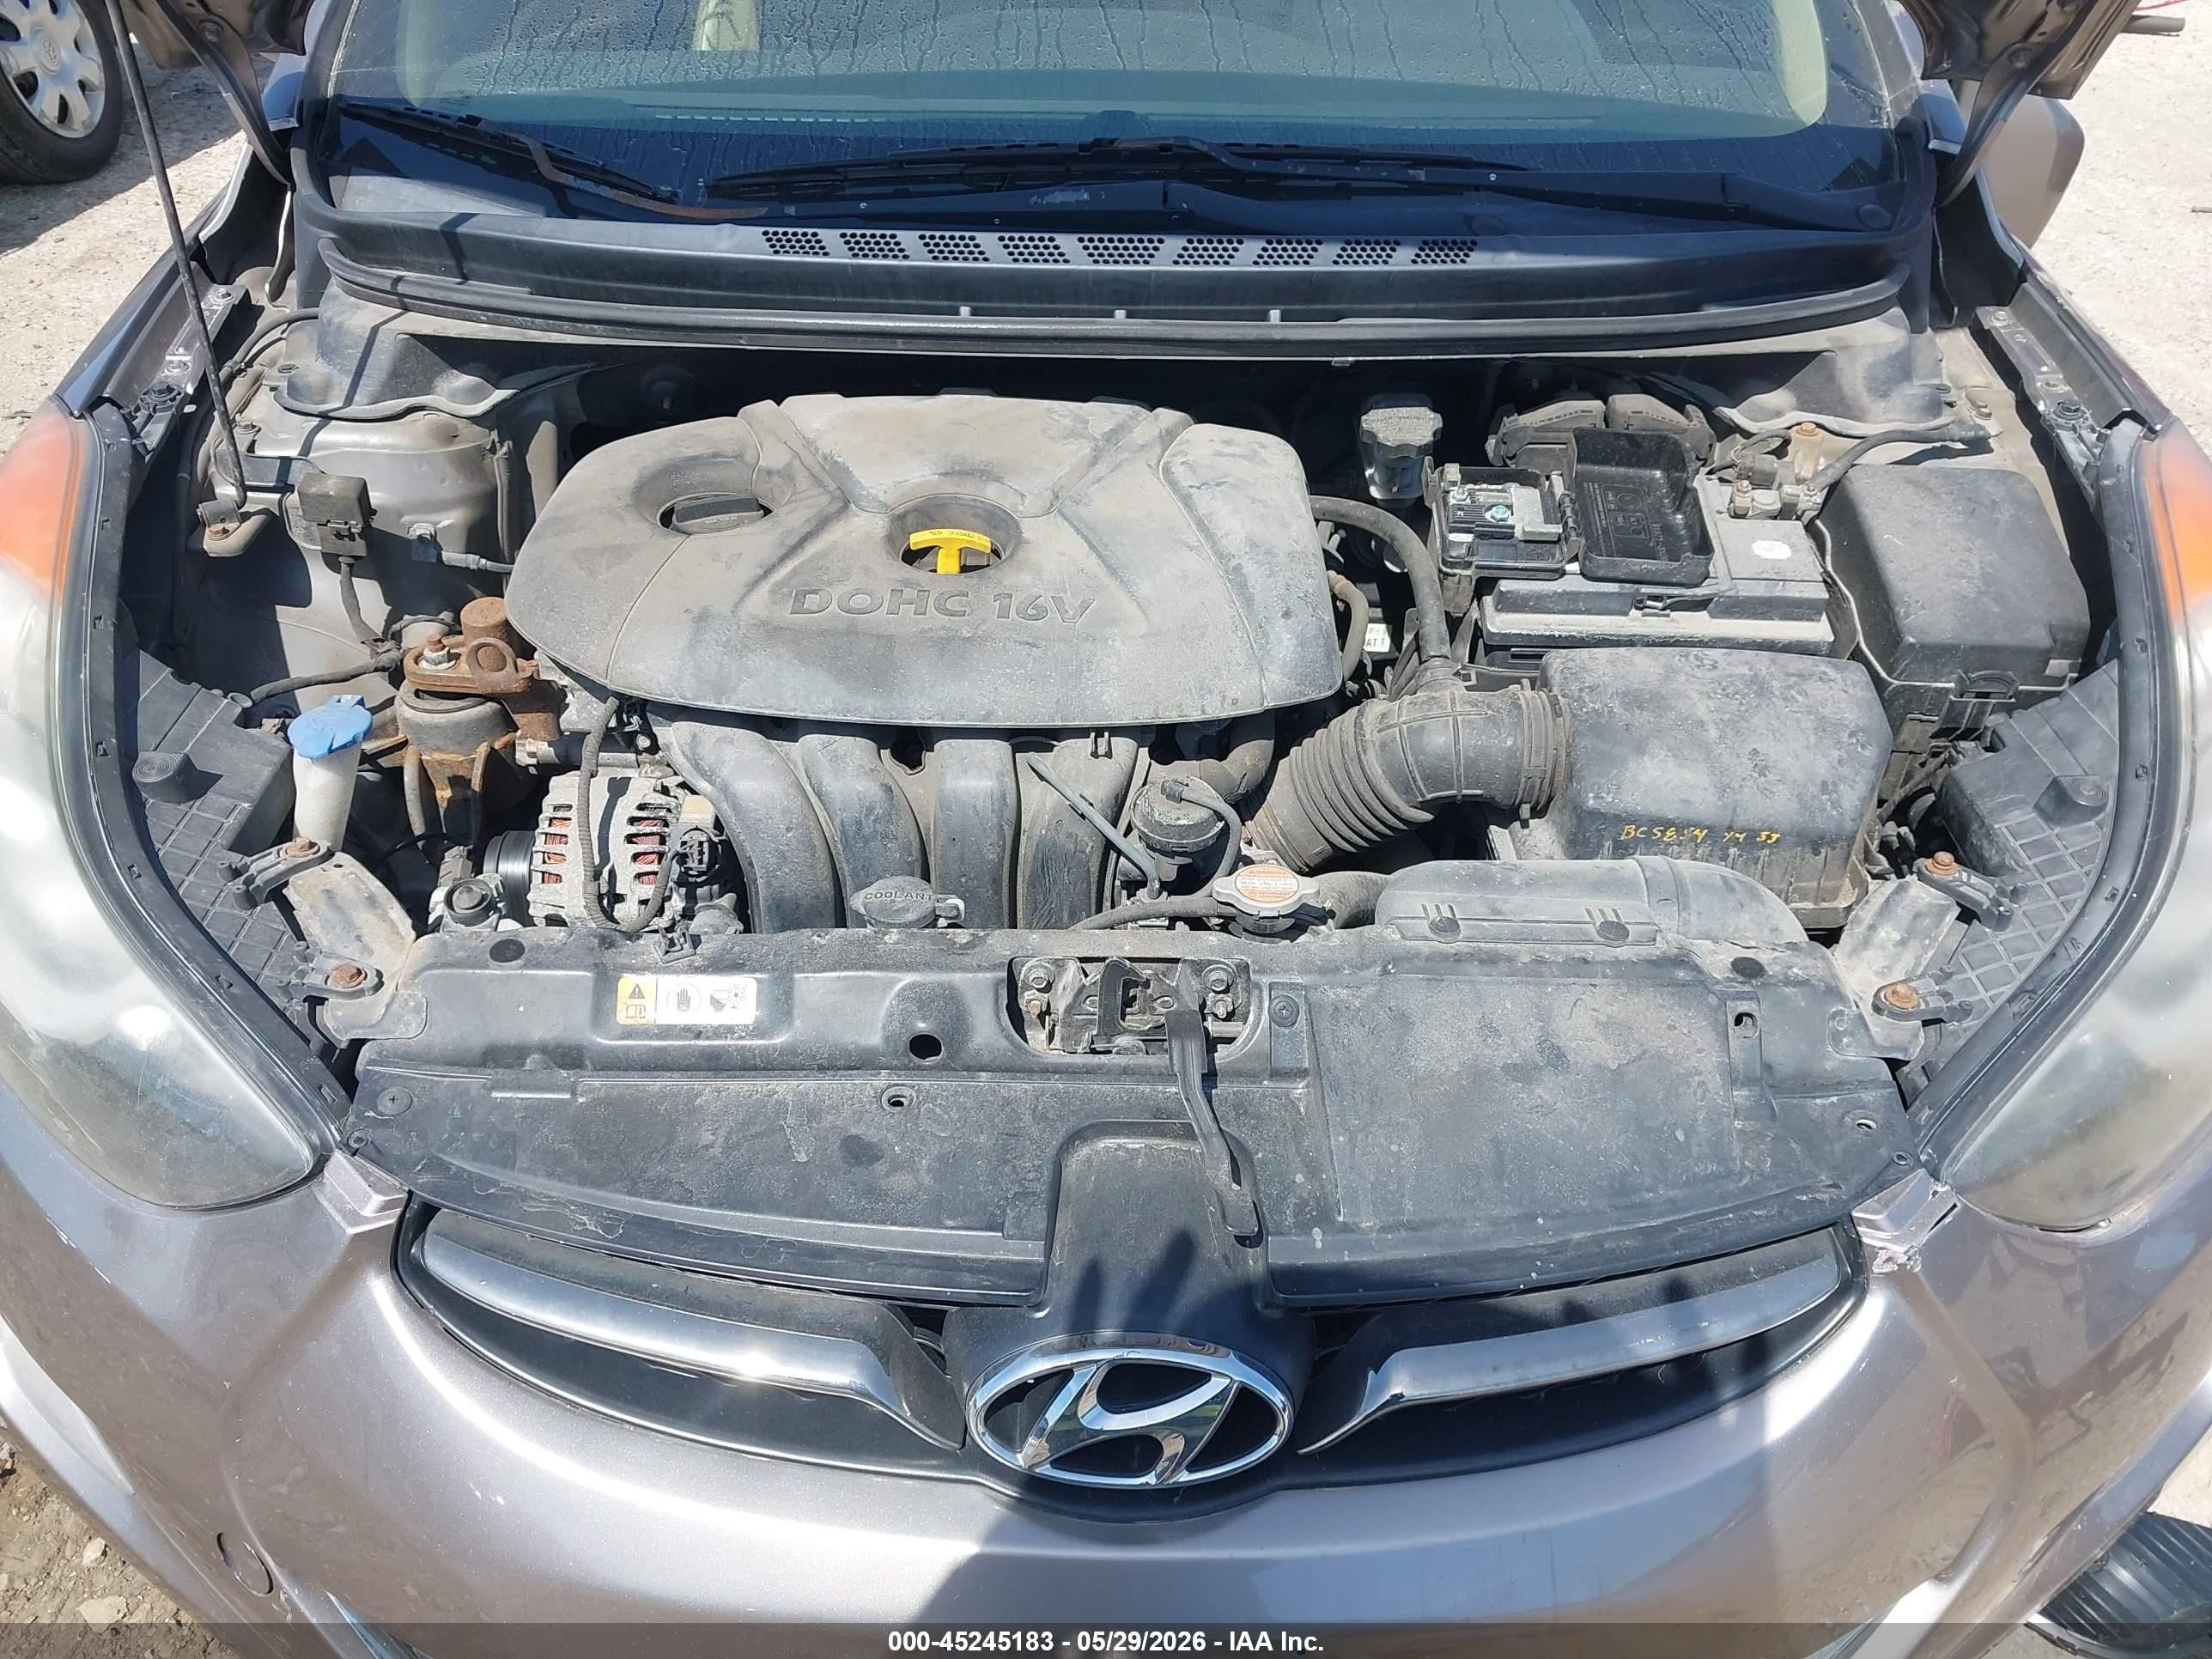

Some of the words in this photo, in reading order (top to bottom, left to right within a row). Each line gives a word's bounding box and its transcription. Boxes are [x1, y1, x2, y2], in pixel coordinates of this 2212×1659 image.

[789, 587, 969, 618] DOHC
[992, 592, 1096, 624] 16V
[864, 890, 936, 902] COOLANT
